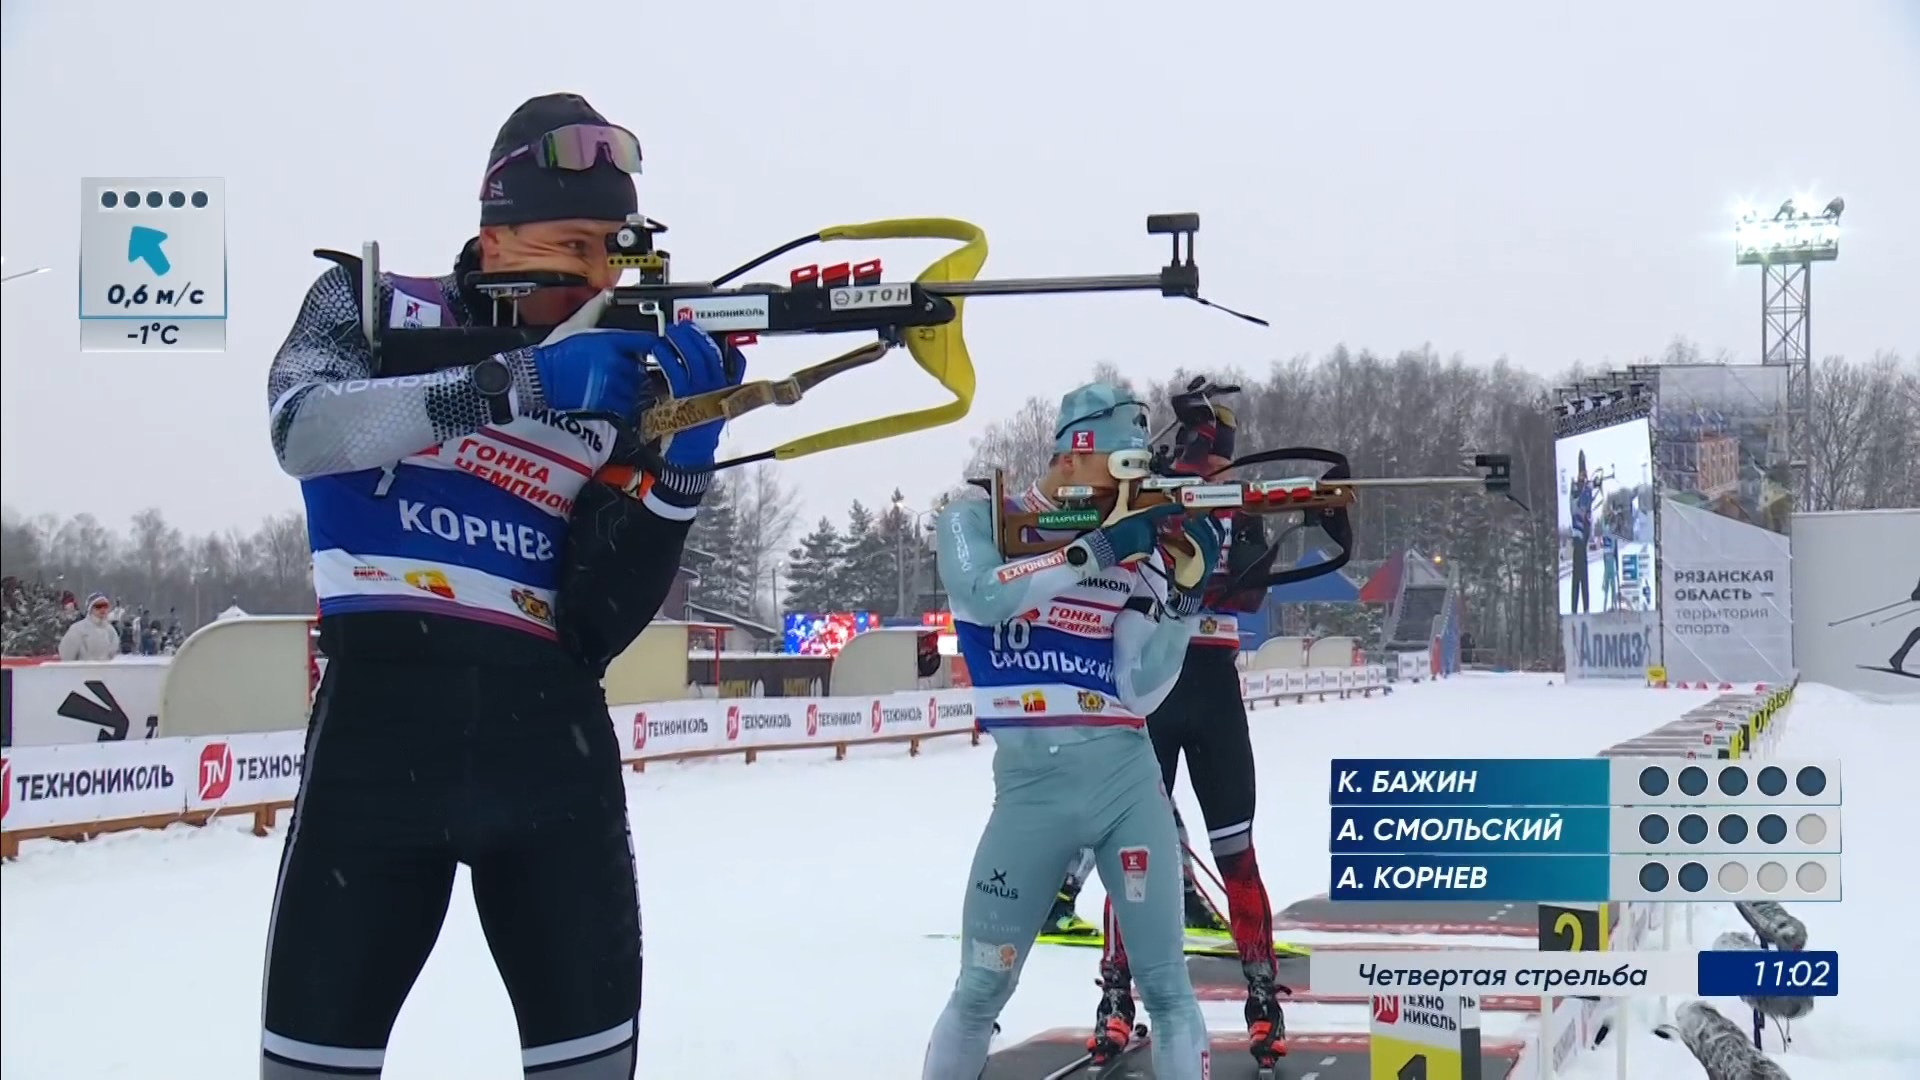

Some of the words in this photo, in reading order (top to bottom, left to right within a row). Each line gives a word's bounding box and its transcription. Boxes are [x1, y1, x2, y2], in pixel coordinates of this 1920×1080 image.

[695, 309, 765, 320] ТЕХНОНИКОЛЬ
[458, 438, 550, 484] ГОНКА
[399, 498, 554, 562] КОРНЕВ
[1674, 570, 1774, 583] РЯЗАНСКАЯ
[1674, 588, 1753, 601] ОБЛАСТЬ
[1049, 606, 1103, 624] ГОНКА
[1676, 608, 1769, 621] территория
[993, 616, 1031, 650] 10
[1675, 624, 1730, 636] спорта
[17, 764, 174, 801] ТЕХНОНИКОЛЬ
[1554, 912, 1584, 951] 2
[1403, 995, 1445, 1011] ТЕХНО
[1403, 1009, 1458, 1032] НИКОЛЬ
